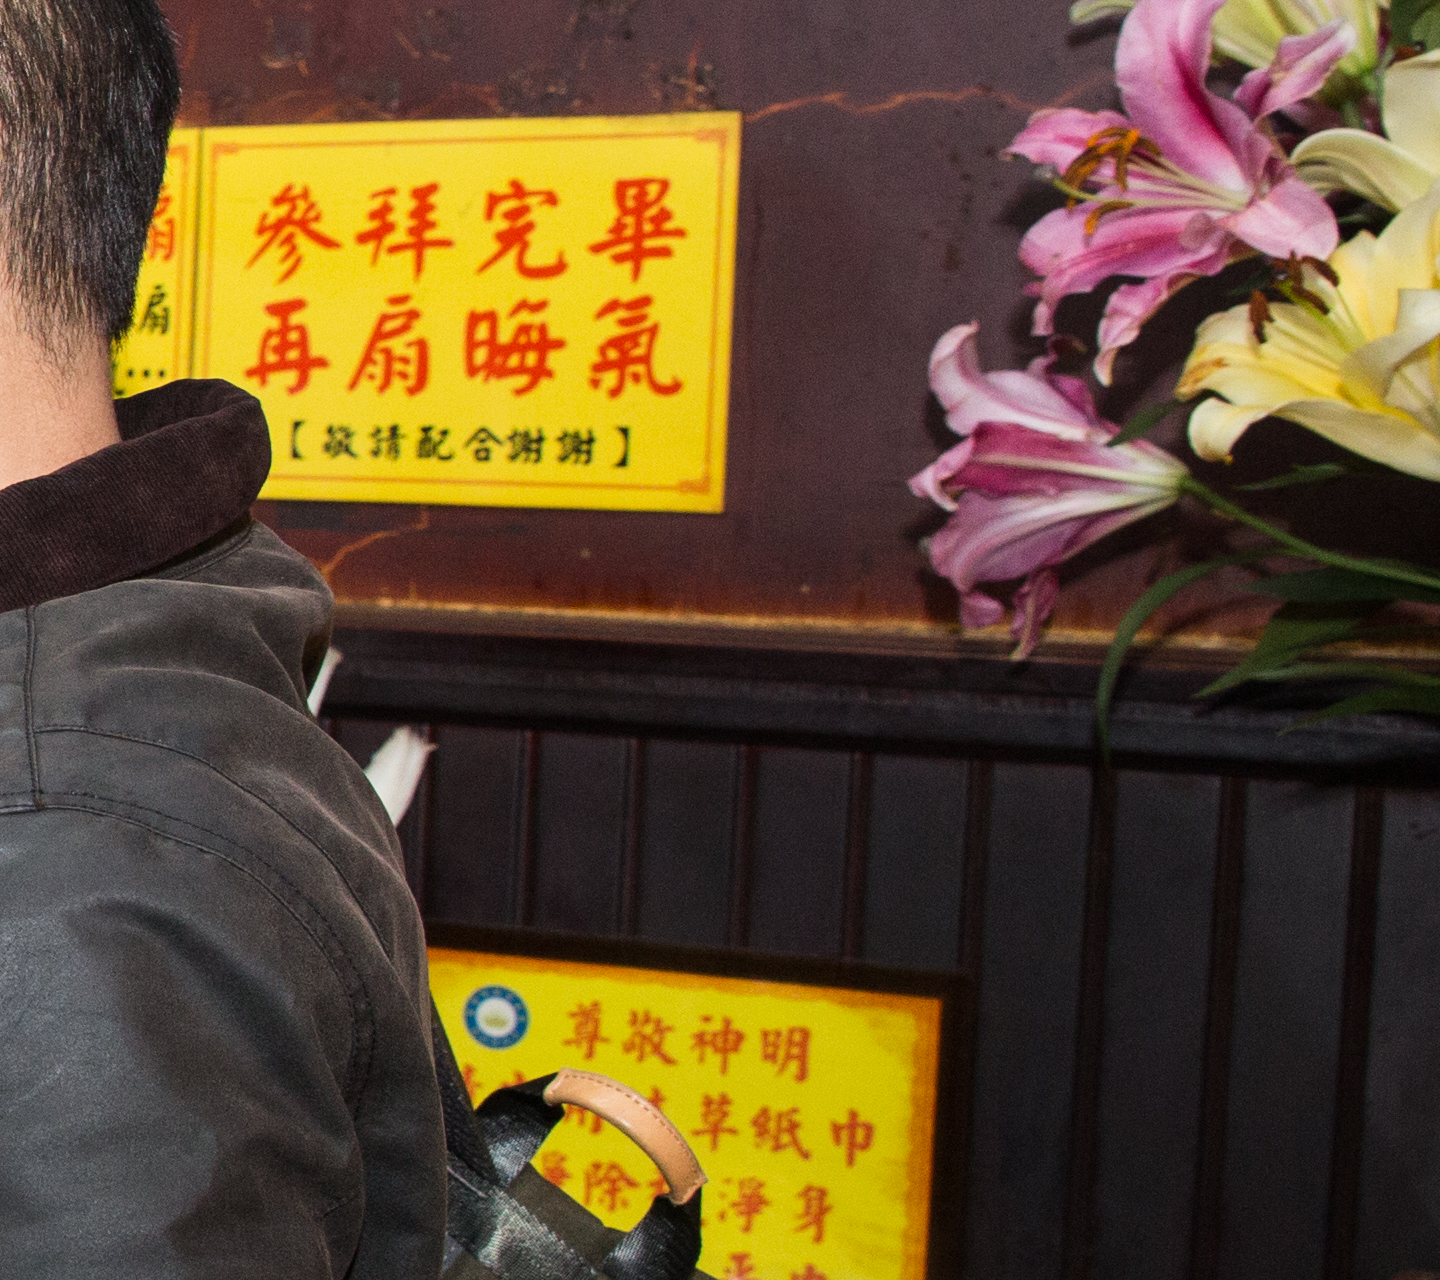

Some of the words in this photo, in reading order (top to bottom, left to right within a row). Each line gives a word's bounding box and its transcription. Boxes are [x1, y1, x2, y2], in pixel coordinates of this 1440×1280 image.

[246, 178, 687, 284] 參拜完畢
[244, 294, 683, 399] 再扇晦氣
[561, 1000, 812, 1084] 尊敬神明
